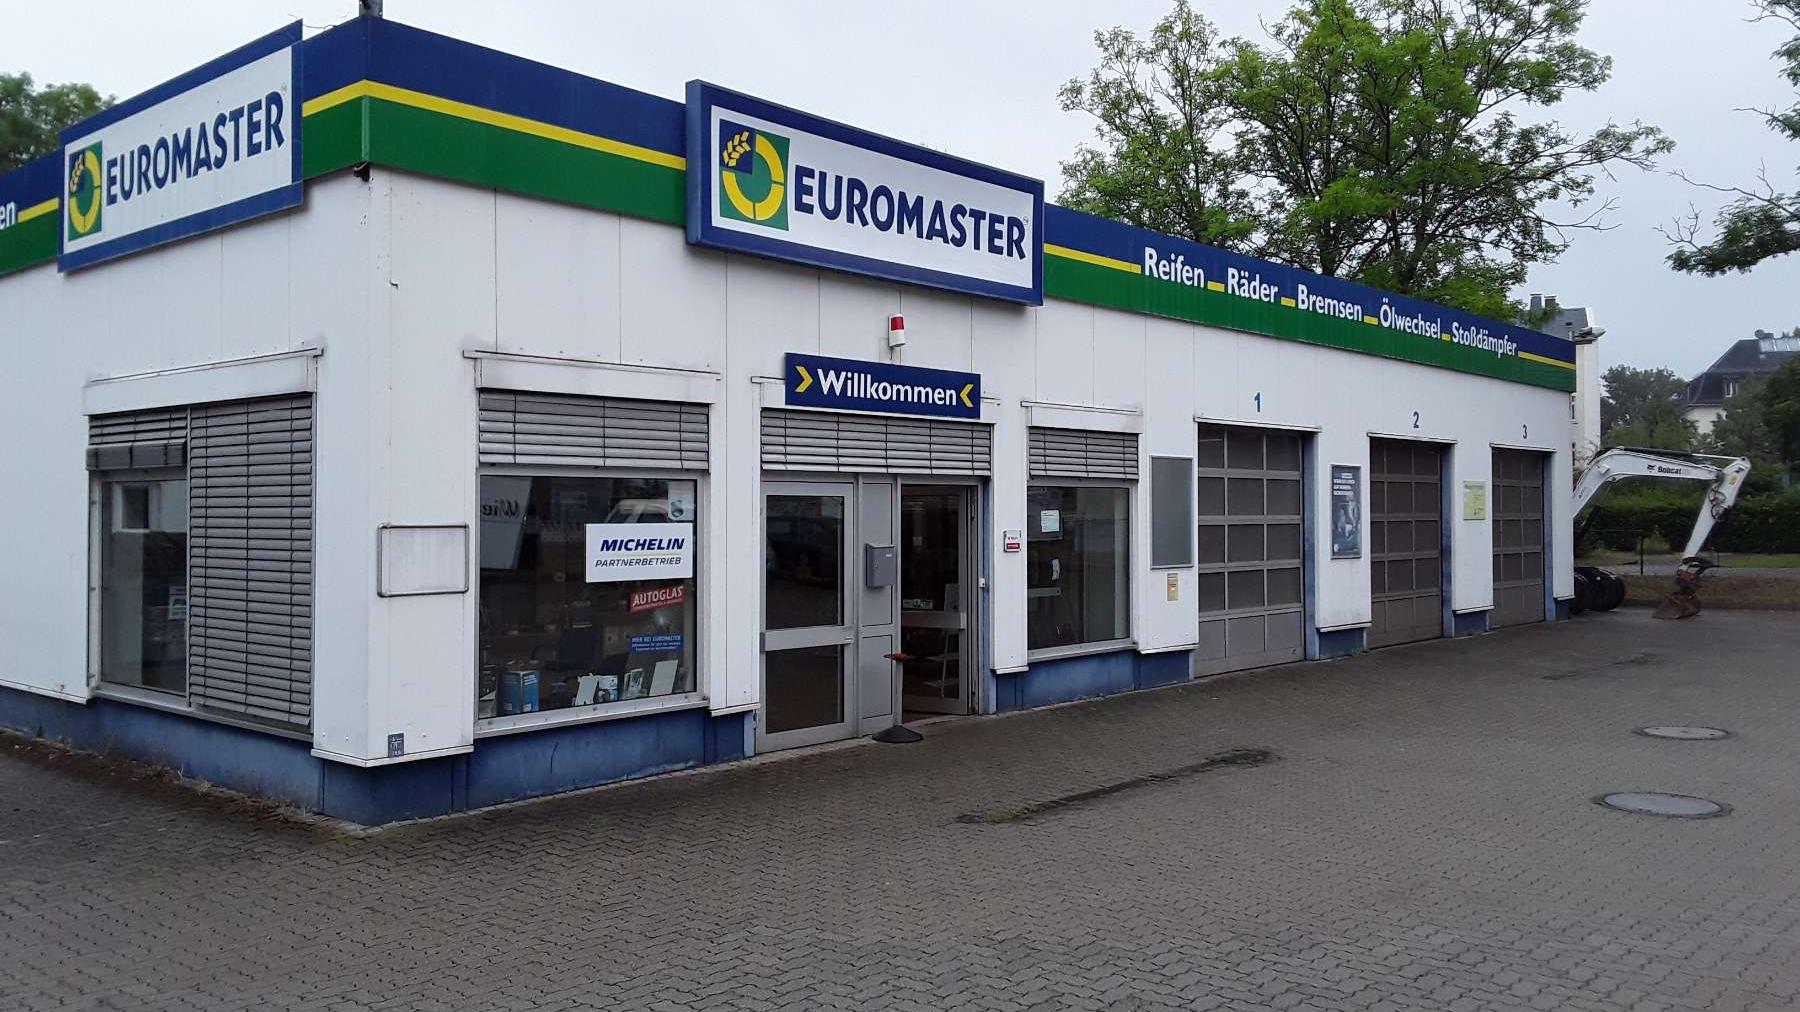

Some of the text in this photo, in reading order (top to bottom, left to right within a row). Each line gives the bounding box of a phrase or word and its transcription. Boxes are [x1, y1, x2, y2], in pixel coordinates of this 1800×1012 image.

[106, 90, 286, 207] EUROMASTER
[795, 165, 1026, 260] EUROMASTER
[1144, 247, 1518, 359] Reifen Räder Bremsen Ölwechsel Stoßdämpfer
[817, 368, 957, 407] Willkommen
[1253, 391, 1261, 413] 1
[1412, 410, 1420, 429] 2
[1522, 424, 1528, 439] 3
[1658, 466, 1682, 475] Bobcat
[600, 538, 684, 551] MICHELIN
[595, 557, 682, 567] PARTNERBETRIEB
[632, 586, 683, 606] AUTOGLAS
